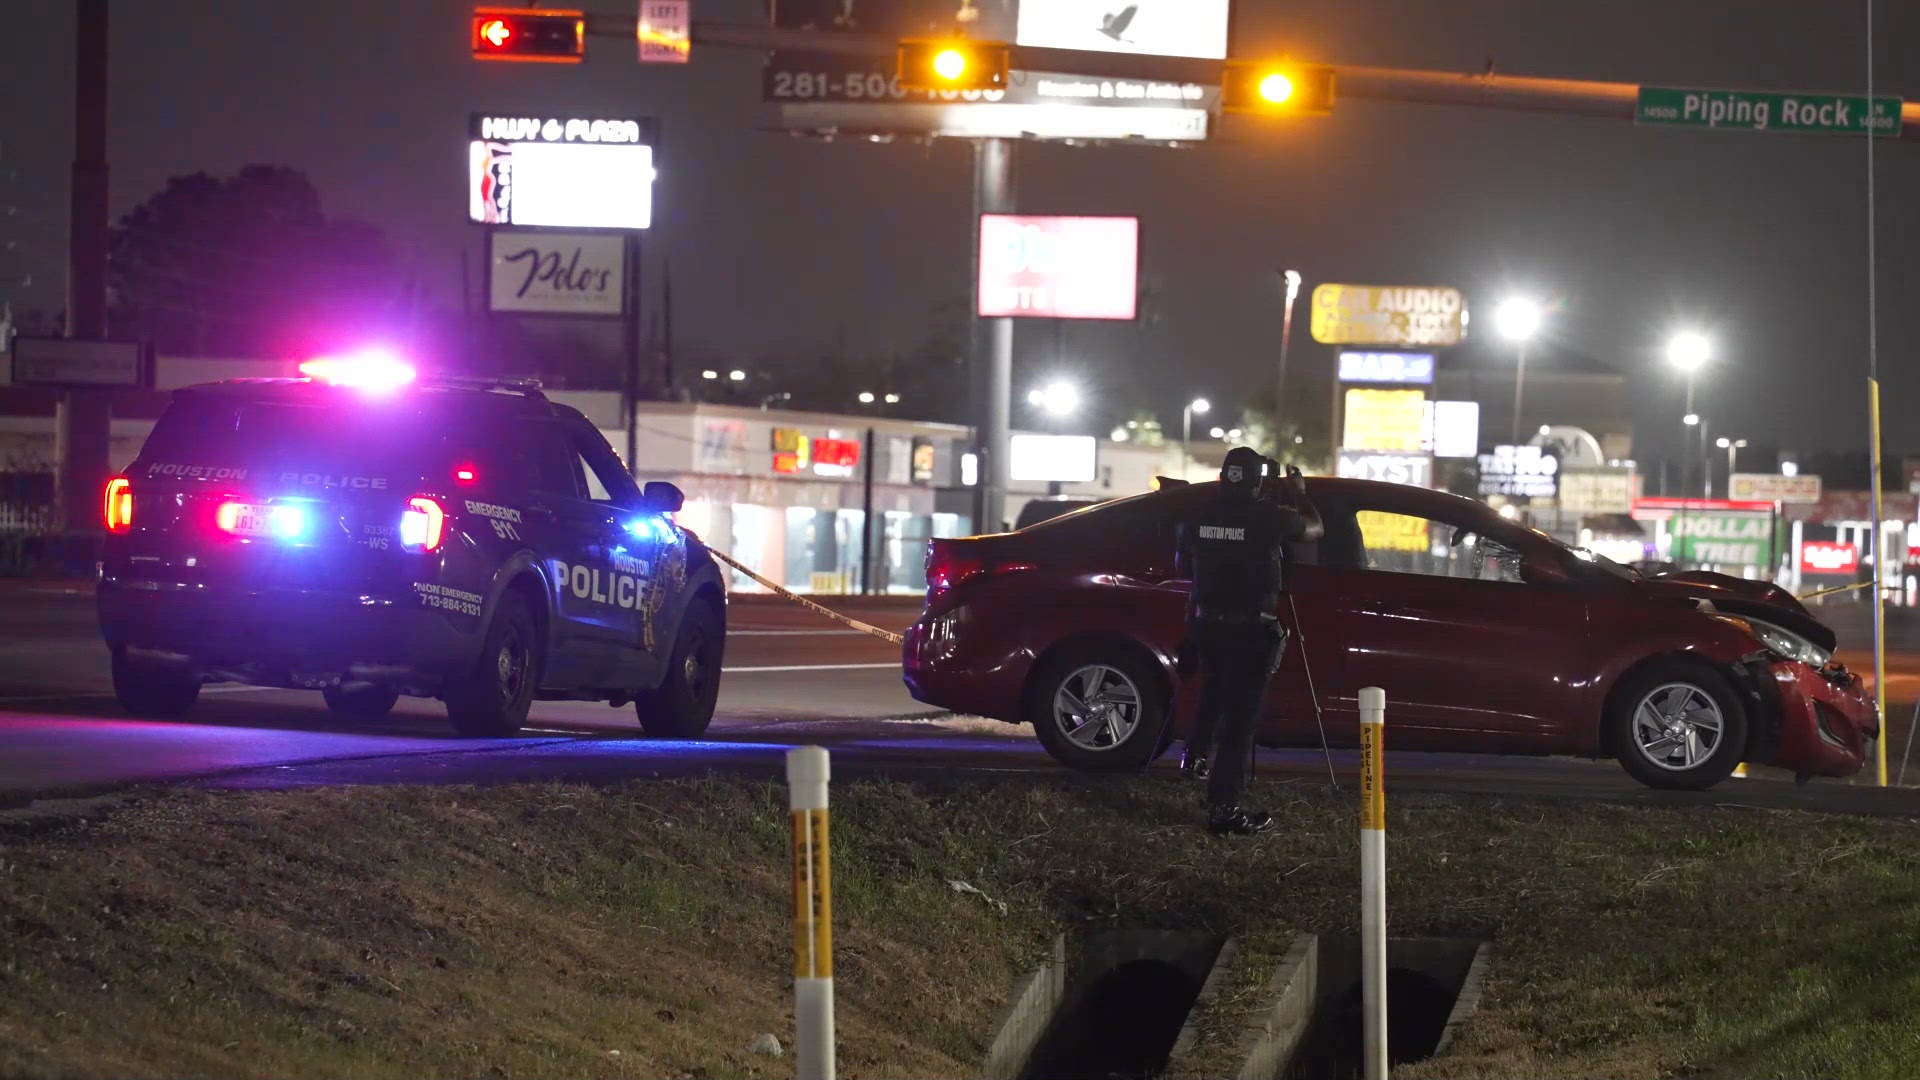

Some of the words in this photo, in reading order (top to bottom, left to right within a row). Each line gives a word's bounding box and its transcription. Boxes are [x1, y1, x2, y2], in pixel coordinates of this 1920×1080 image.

[1684, 94, 1769, 130] Piping
[1782, 99, 1849, 127] Rock
[482, 117, 540, 140] HWY
[565, 119, 640, 143] PLAZA
[504, 247, 613, 299] Polo's
[1318, 288, 1369, 311] CAR
[1376, 287, 1461, 312] AUDIO
[149, 462, 248, 480] HOUSTON
[279, 471, 388, 490] POLICE
[1338, 455, 1430, 485] MYST
[464, 500, 522, 523] EMERGENCY
[490, 519, 521, 541] 911
[1199, 525, 1224, 540] HOUSTON
[1224, 527, 1245, 541] POLICE
[369, 536, 388, 550] WS
[1694, 541, 1759, 563] TREE
[613, 554, 650, 576] HOUSTON
[417, 582, 440, 594] NON
[441, 587, 483, 604] EMERGENCY
[552, 559, 649, 611] POLICE
[419, 593, 481, 617] 713-884-3131
[1364, 727, 1373, 791] PIPELINE
